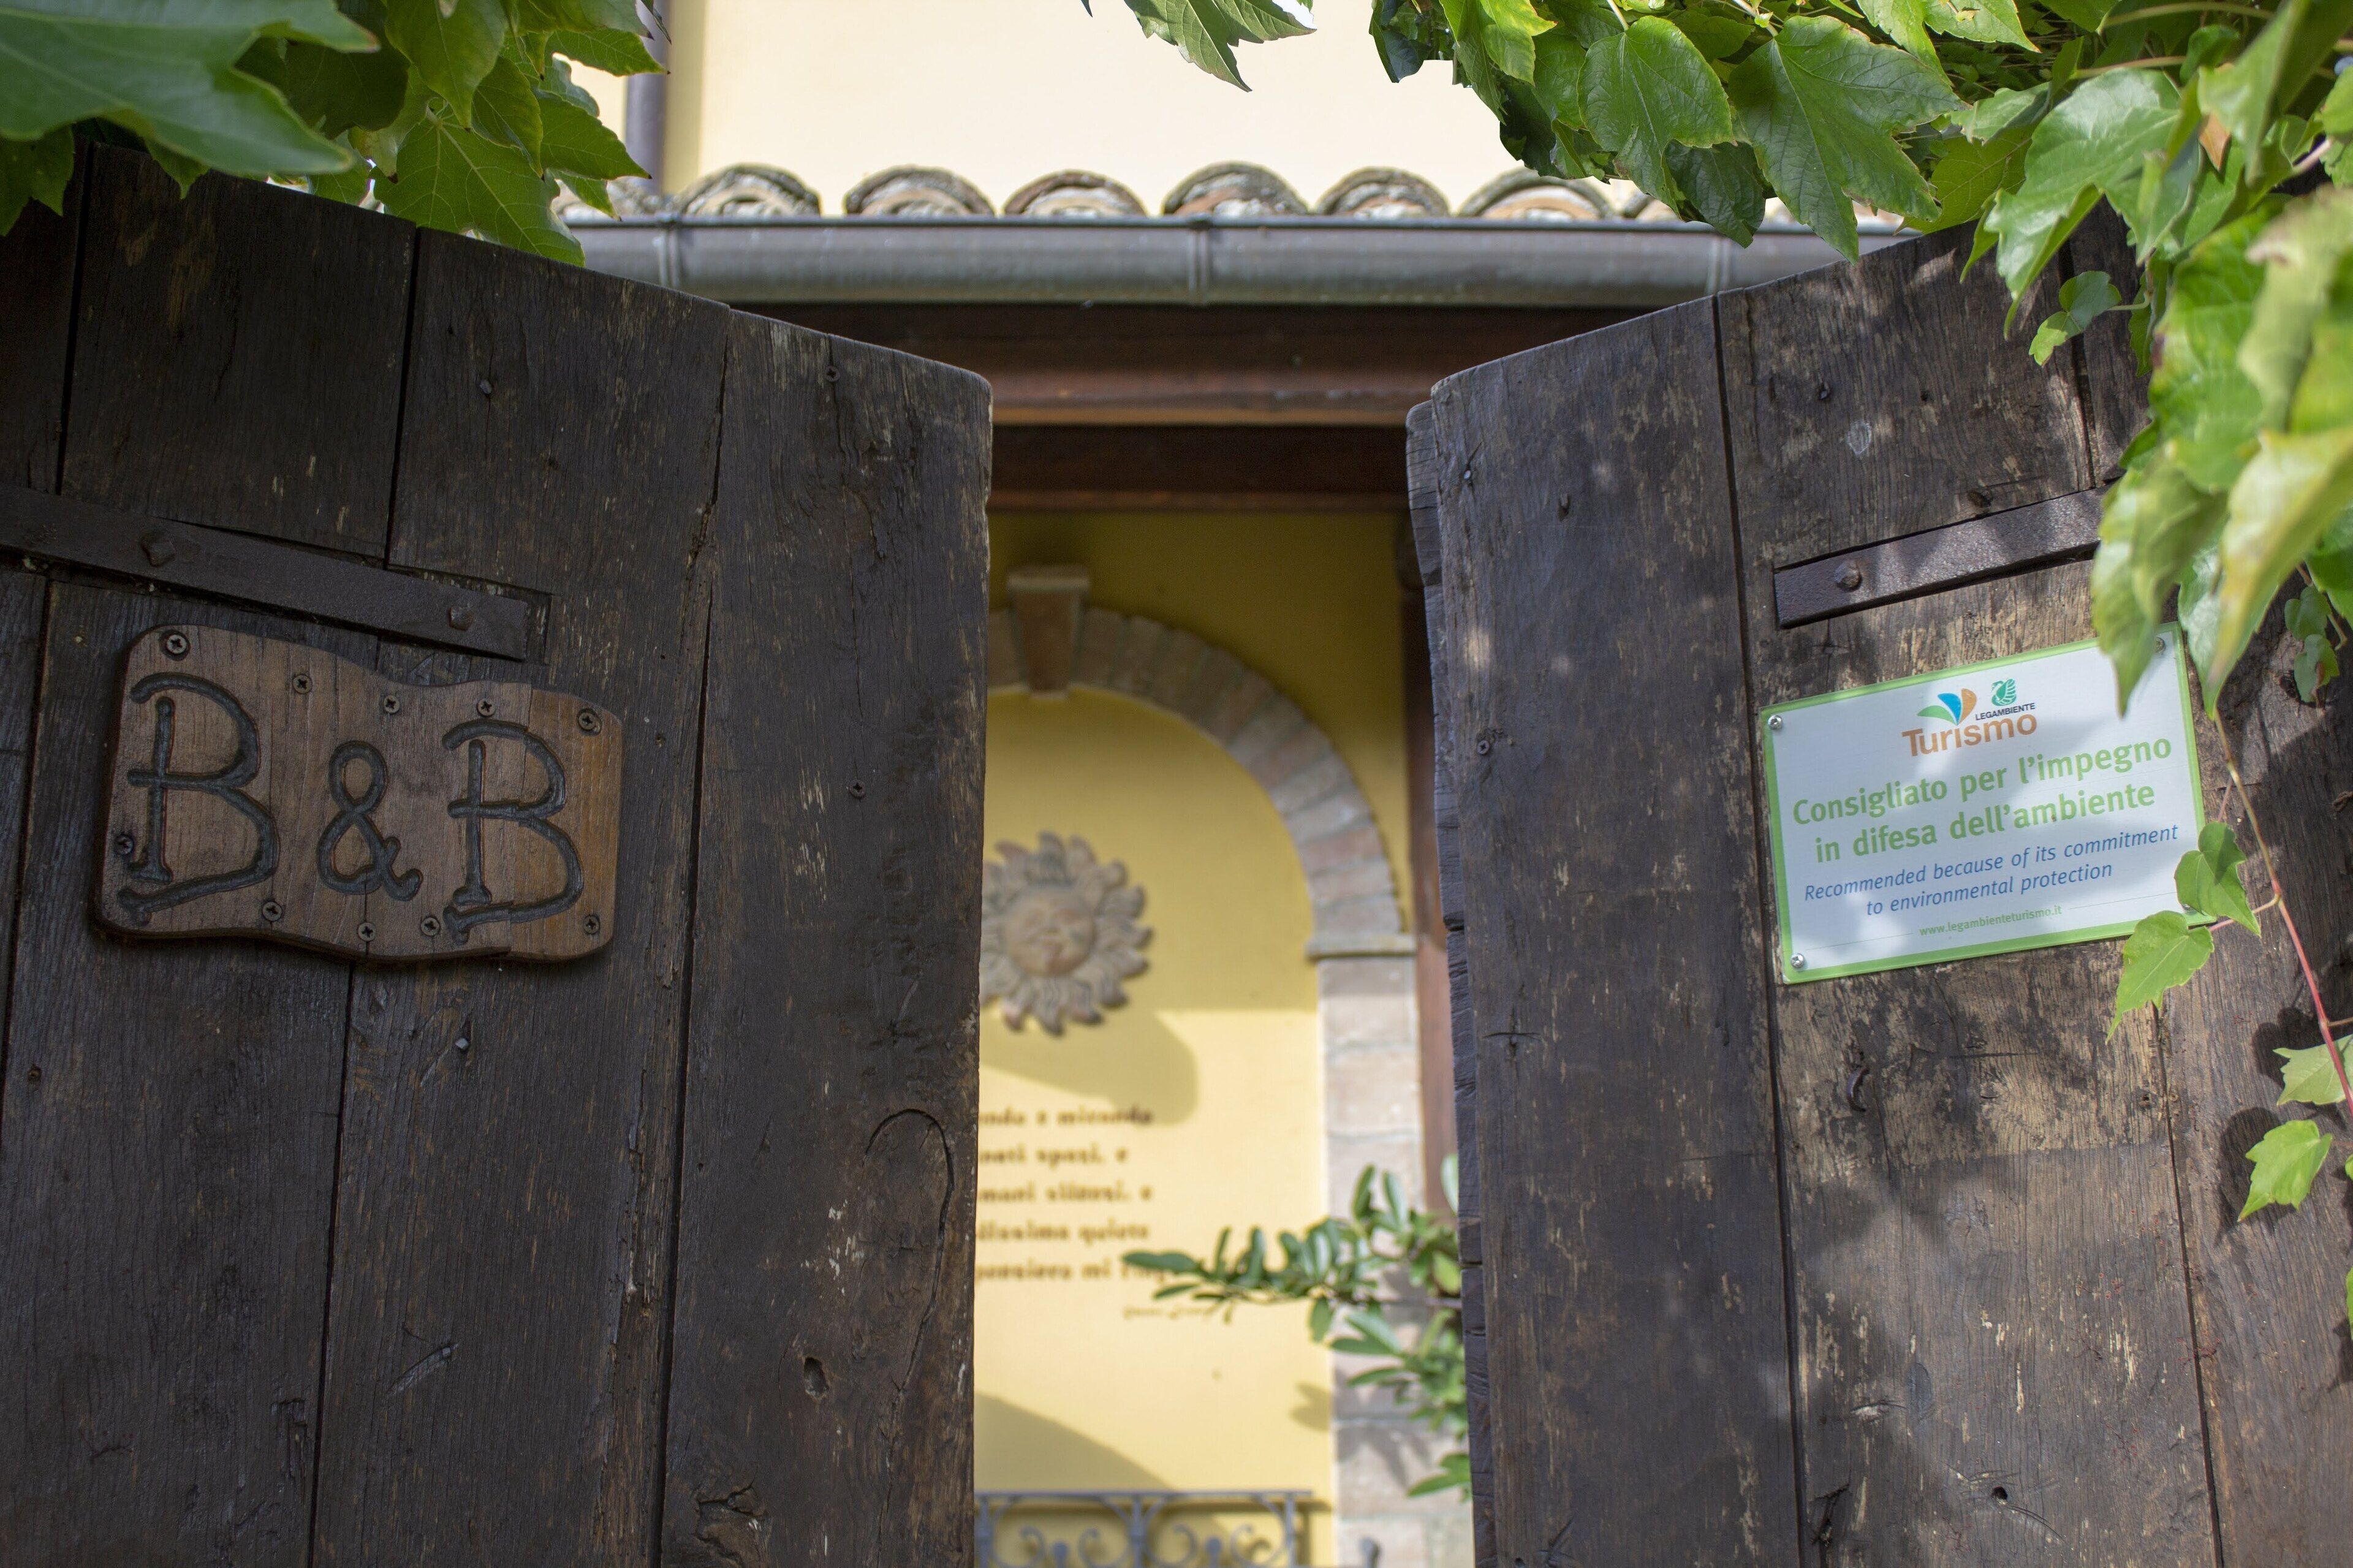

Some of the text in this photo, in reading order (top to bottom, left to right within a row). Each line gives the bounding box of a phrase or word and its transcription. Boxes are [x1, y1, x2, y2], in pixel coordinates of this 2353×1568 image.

[1901, 714, 2037, 756] Turismo
[1975, 702, 2036, 721] LEGAMBIENTE
[1793, 738, 2172, 824] Consigliato per l’impegno
[1815, 784, 2156, 863] in difesa dell’ambiente
[1804, 825, 2178, 900] Recommended because of its commitment
[1866, 863, 2113, 916] to environmental protection
[1919, 906, 2062, 934] www.legambienteturismo.it
